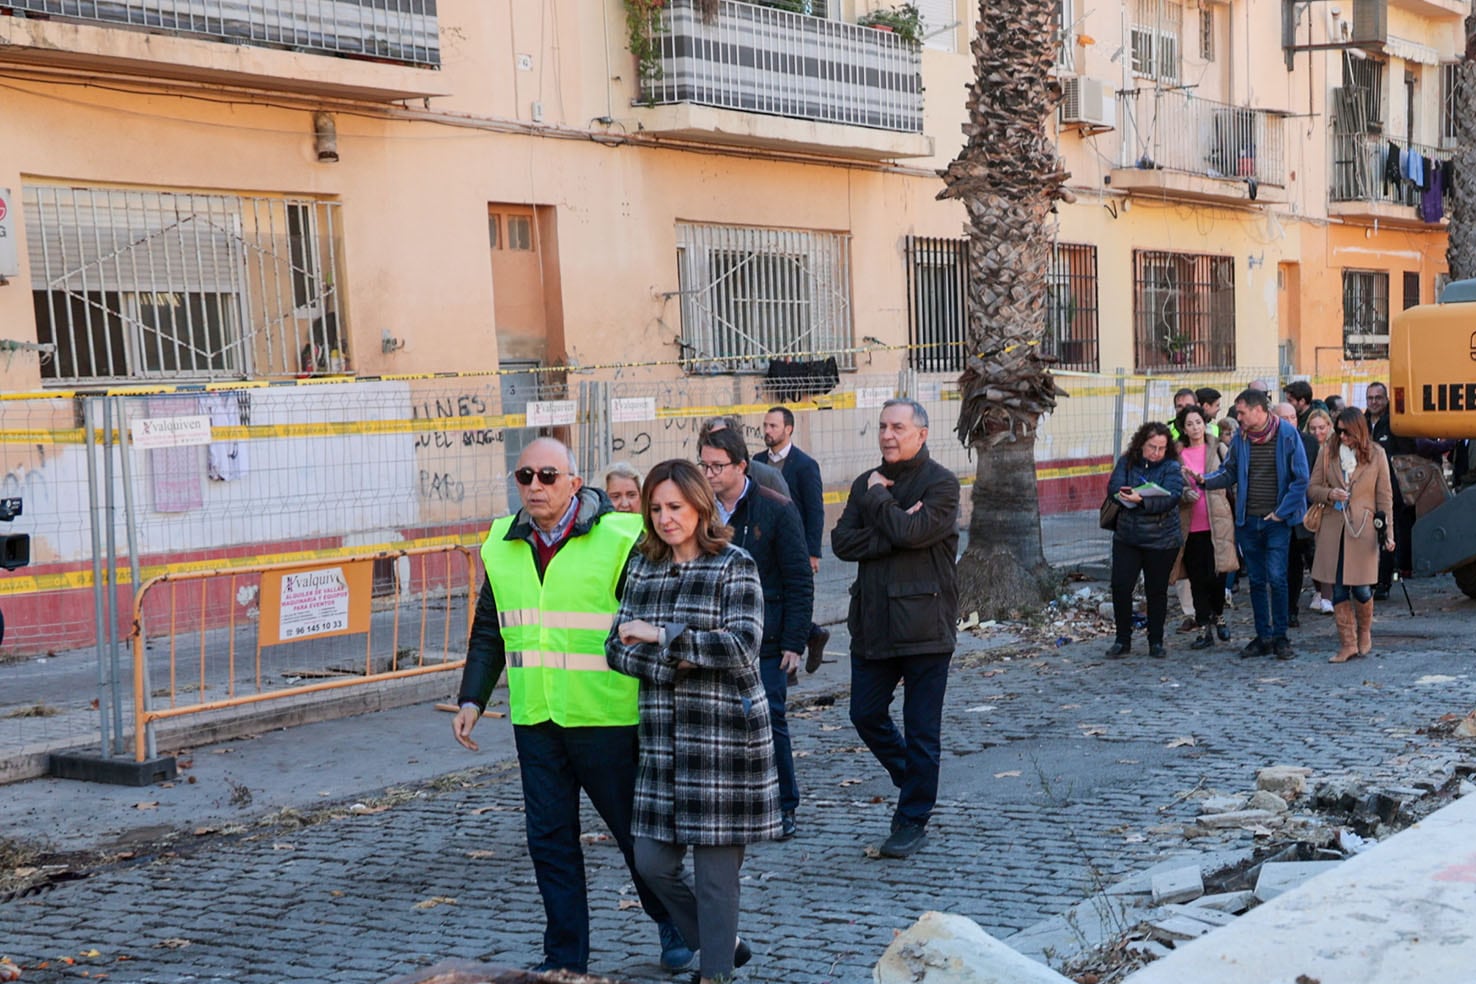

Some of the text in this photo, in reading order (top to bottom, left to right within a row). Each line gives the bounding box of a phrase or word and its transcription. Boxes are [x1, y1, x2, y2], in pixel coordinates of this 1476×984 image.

[281, 596, 317, 607] MAQUINARIA
[323, 591, 348, 600] EQUIPOS
[309, 600, 335, 609] EVENTOS
[296, 627, 305, 635] 96
[307, 624, 320, 632] 145
[322, 622, 331, 630] 10
[333, 620, 342, 628] 33
